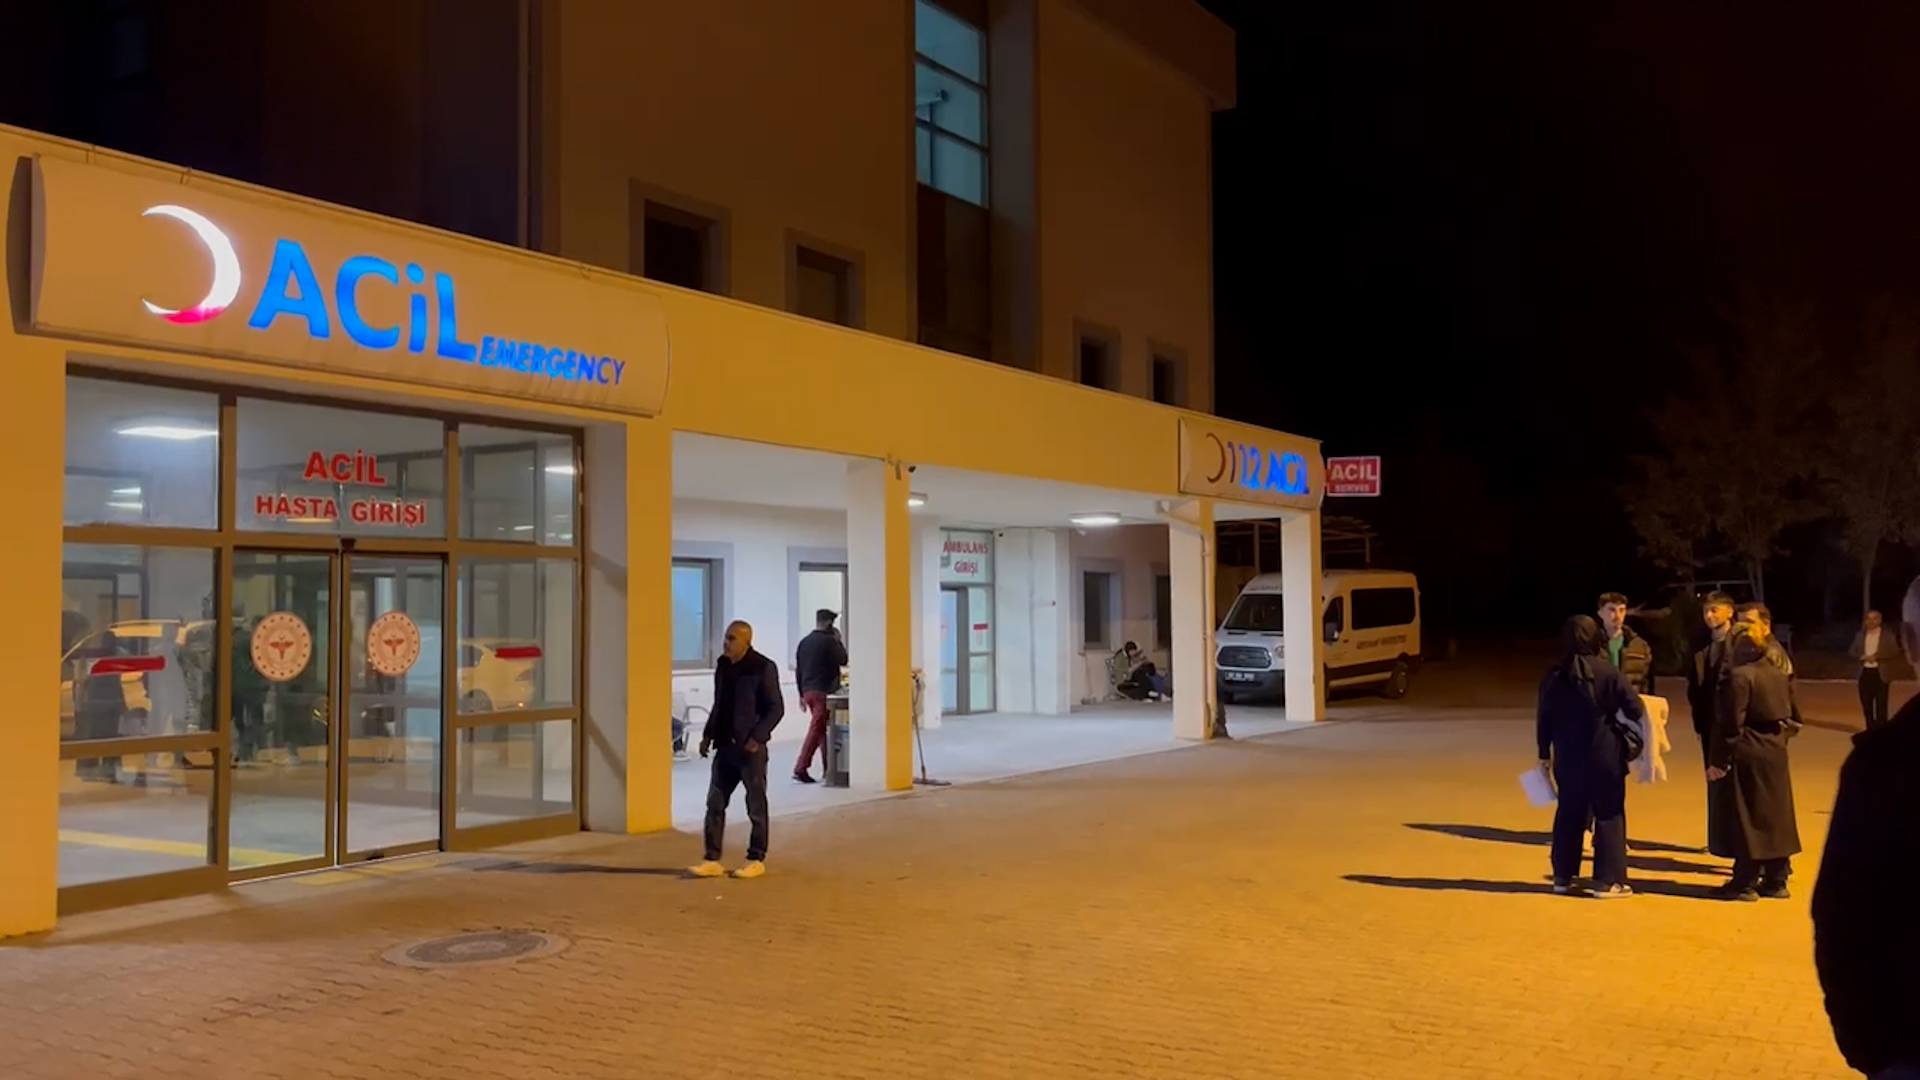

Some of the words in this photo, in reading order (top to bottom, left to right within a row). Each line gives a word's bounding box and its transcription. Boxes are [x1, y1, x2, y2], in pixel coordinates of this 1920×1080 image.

[479, 336, 626, 385] EMERGENCY
[1227, 441, 1261, 490] 112
[256, 495, 339, 519] HASTA
[351, 498, 426, 528] GİRİŞİ
[943, 540, 989, 554] AMBULANS
